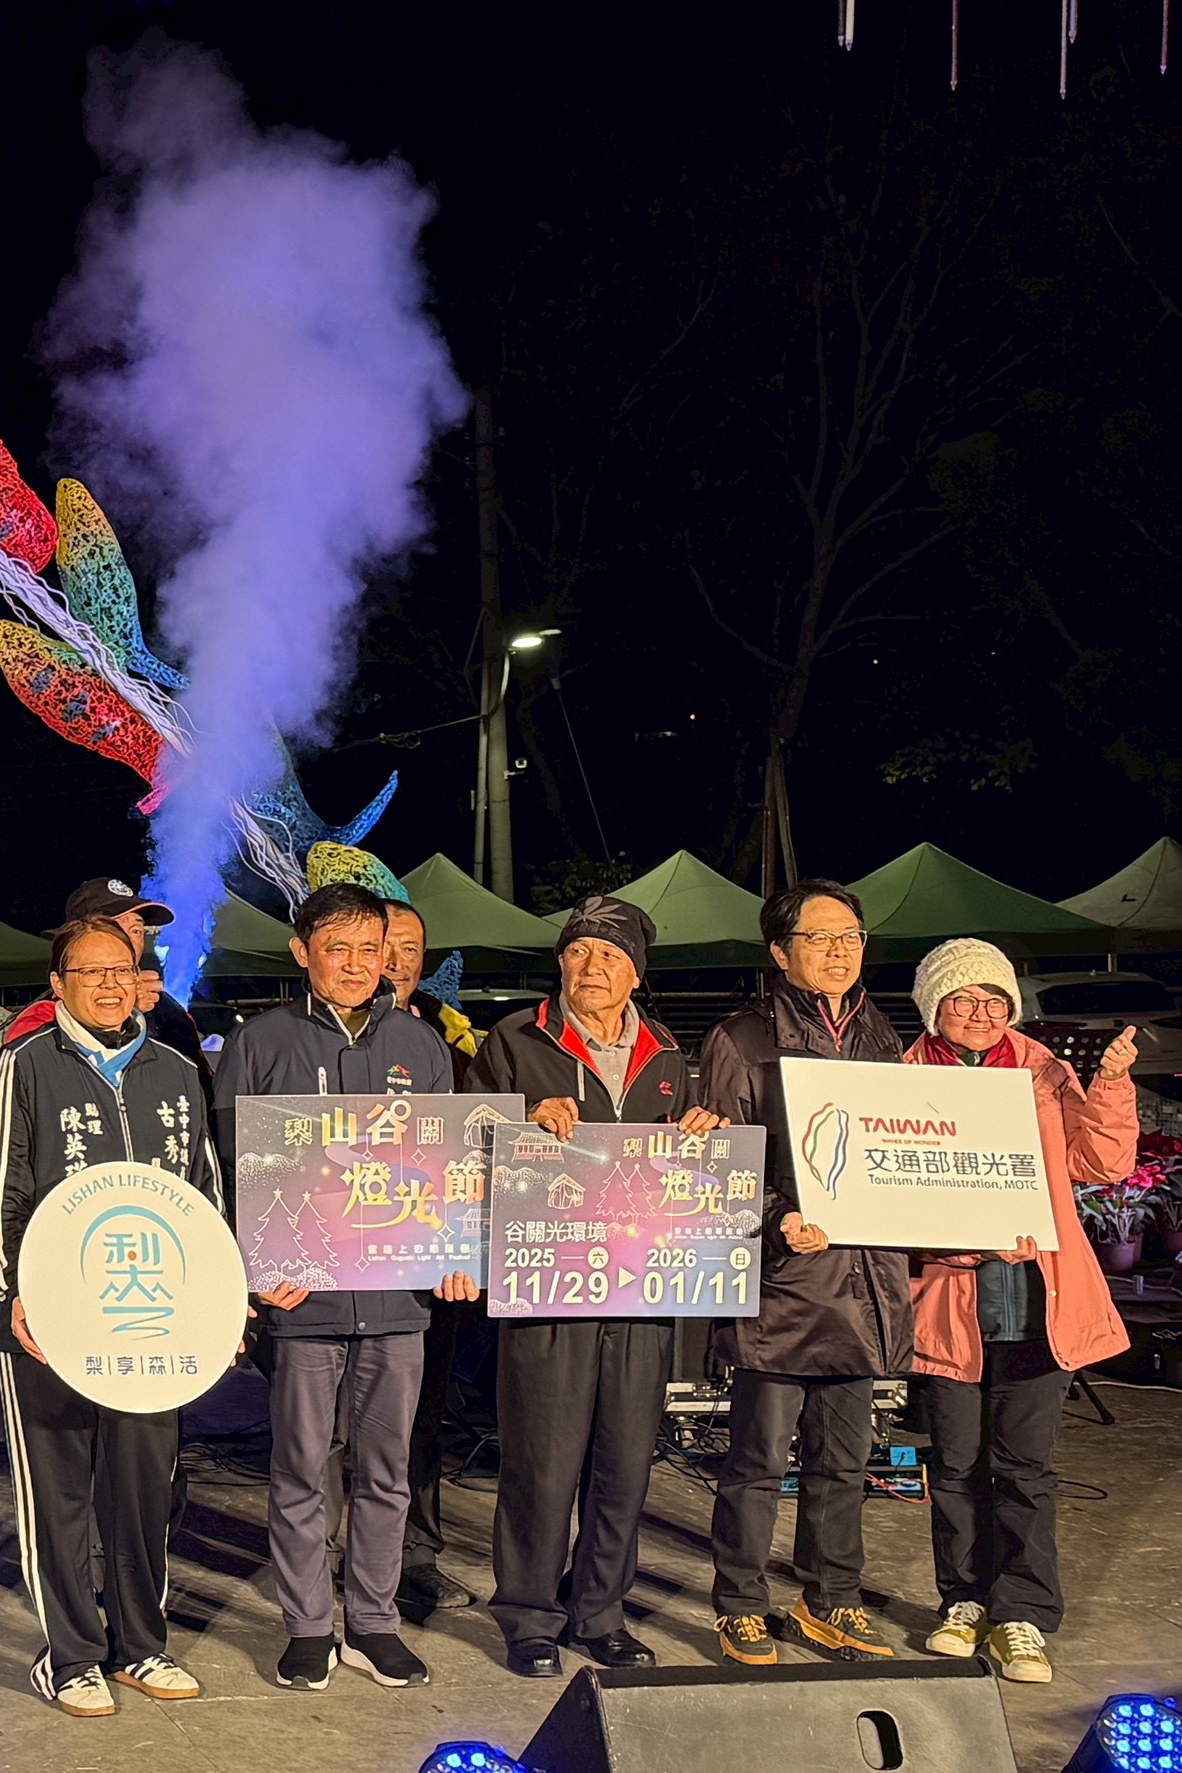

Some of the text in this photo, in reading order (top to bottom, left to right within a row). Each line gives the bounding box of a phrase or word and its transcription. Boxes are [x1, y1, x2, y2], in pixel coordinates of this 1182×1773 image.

[859, 1117, 956, 1137] TAIWAN
[865, 1148, 1037, 1178] 交通部觀光署
[62, 1174, 194, 1216] LISHAN LIFESTYLE
[340, 1160, 487, 1229] 燈光節
[658, 1169, 757, 1217] 燈光節
[868, 1174, 1039, 1191] Tourism Administration, MOTC
[504, 1220, 608, 1243] 谷關光環境
[504, 1248, 555, 1268] 2025
[646, 1248, 697, 1268] 2026
[502, 1271, 609, 1305] 11/29
[642, 1271, 747, 1305] 01/11
